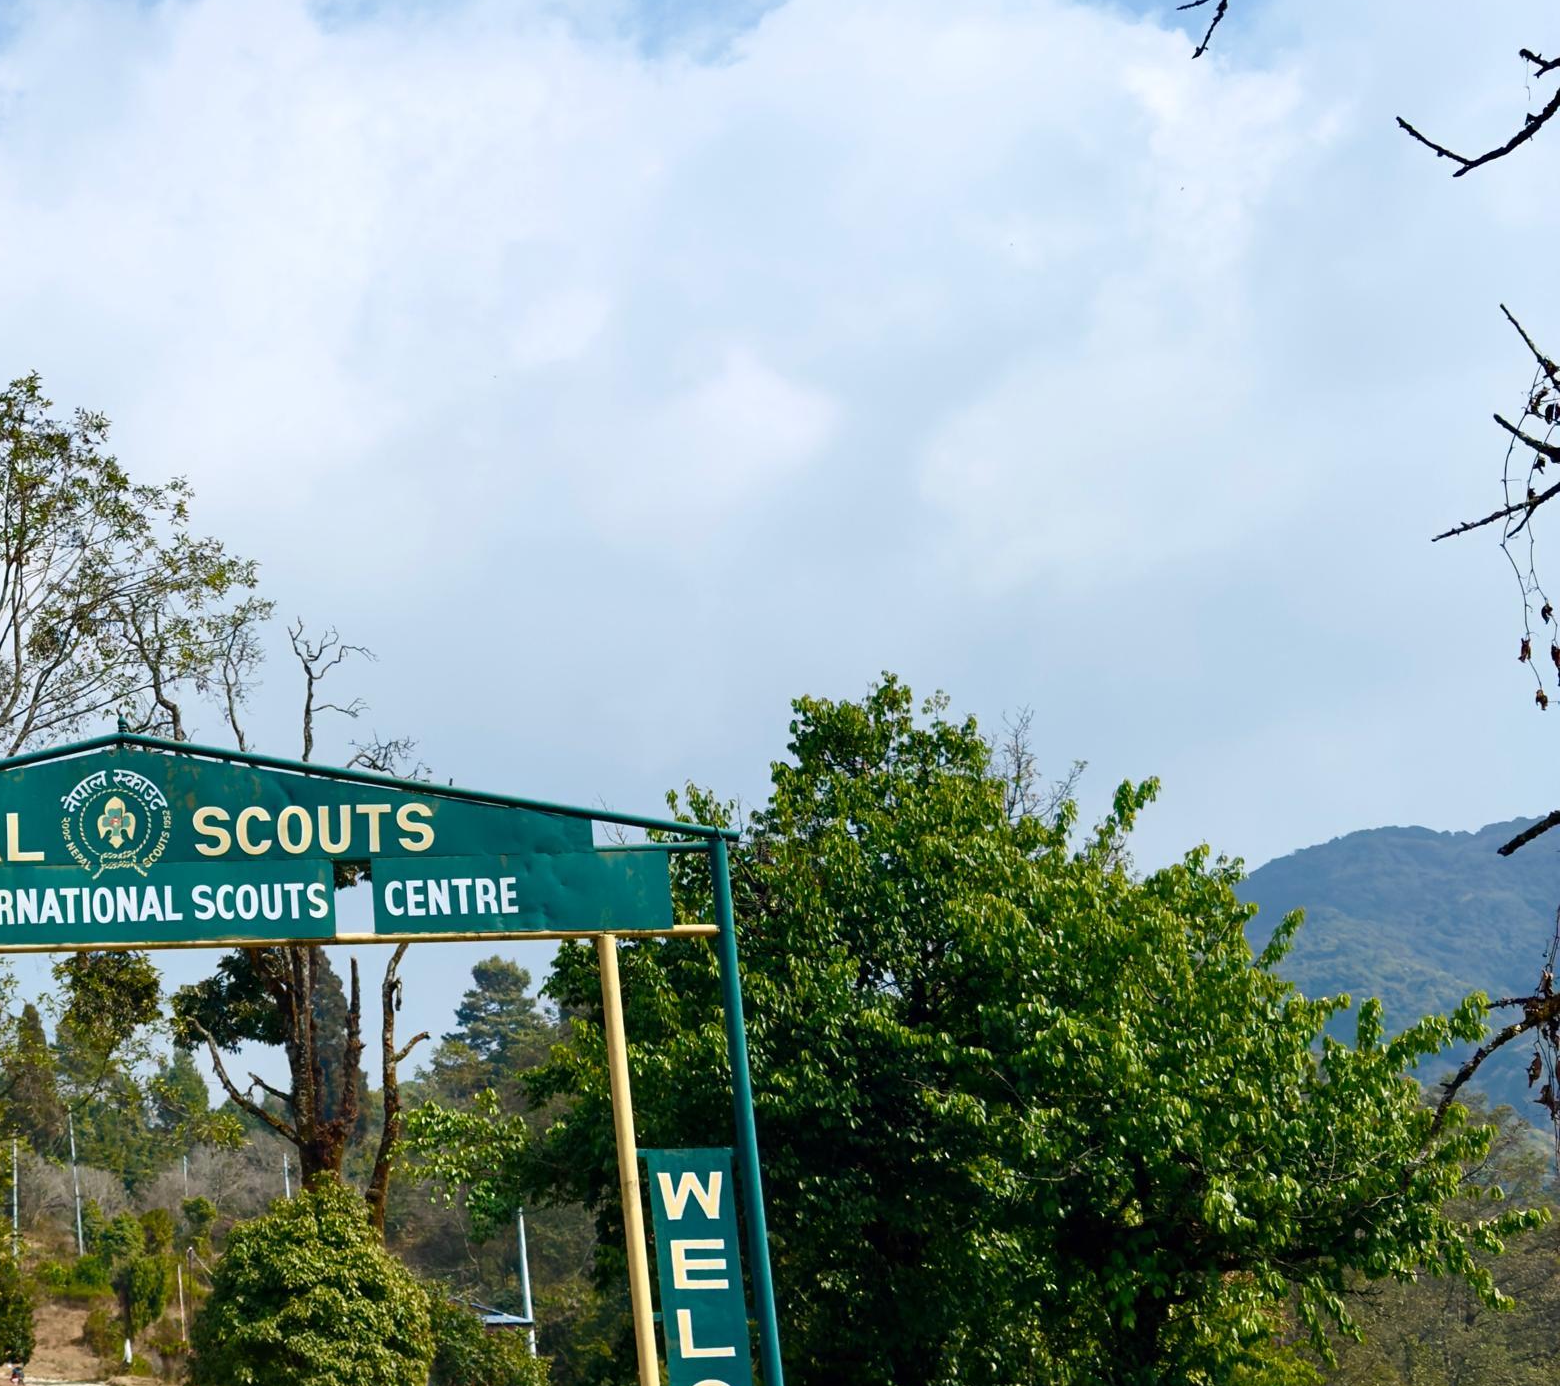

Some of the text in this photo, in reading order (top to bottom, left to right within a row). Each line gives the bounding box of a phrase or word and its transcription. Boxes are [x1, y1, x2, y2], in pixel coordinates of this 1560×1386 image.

[60, 769, 168, 812] नेपाल स्काउट
[66, 841, 92, 871] NEPAL
[142, 831, 170, 868] SCOUTS
[192, 803, 435, 856] SCOUTS
[192, 883, 329, 921] SCOUTS
[384, 877, 519, 915] CENTRE
